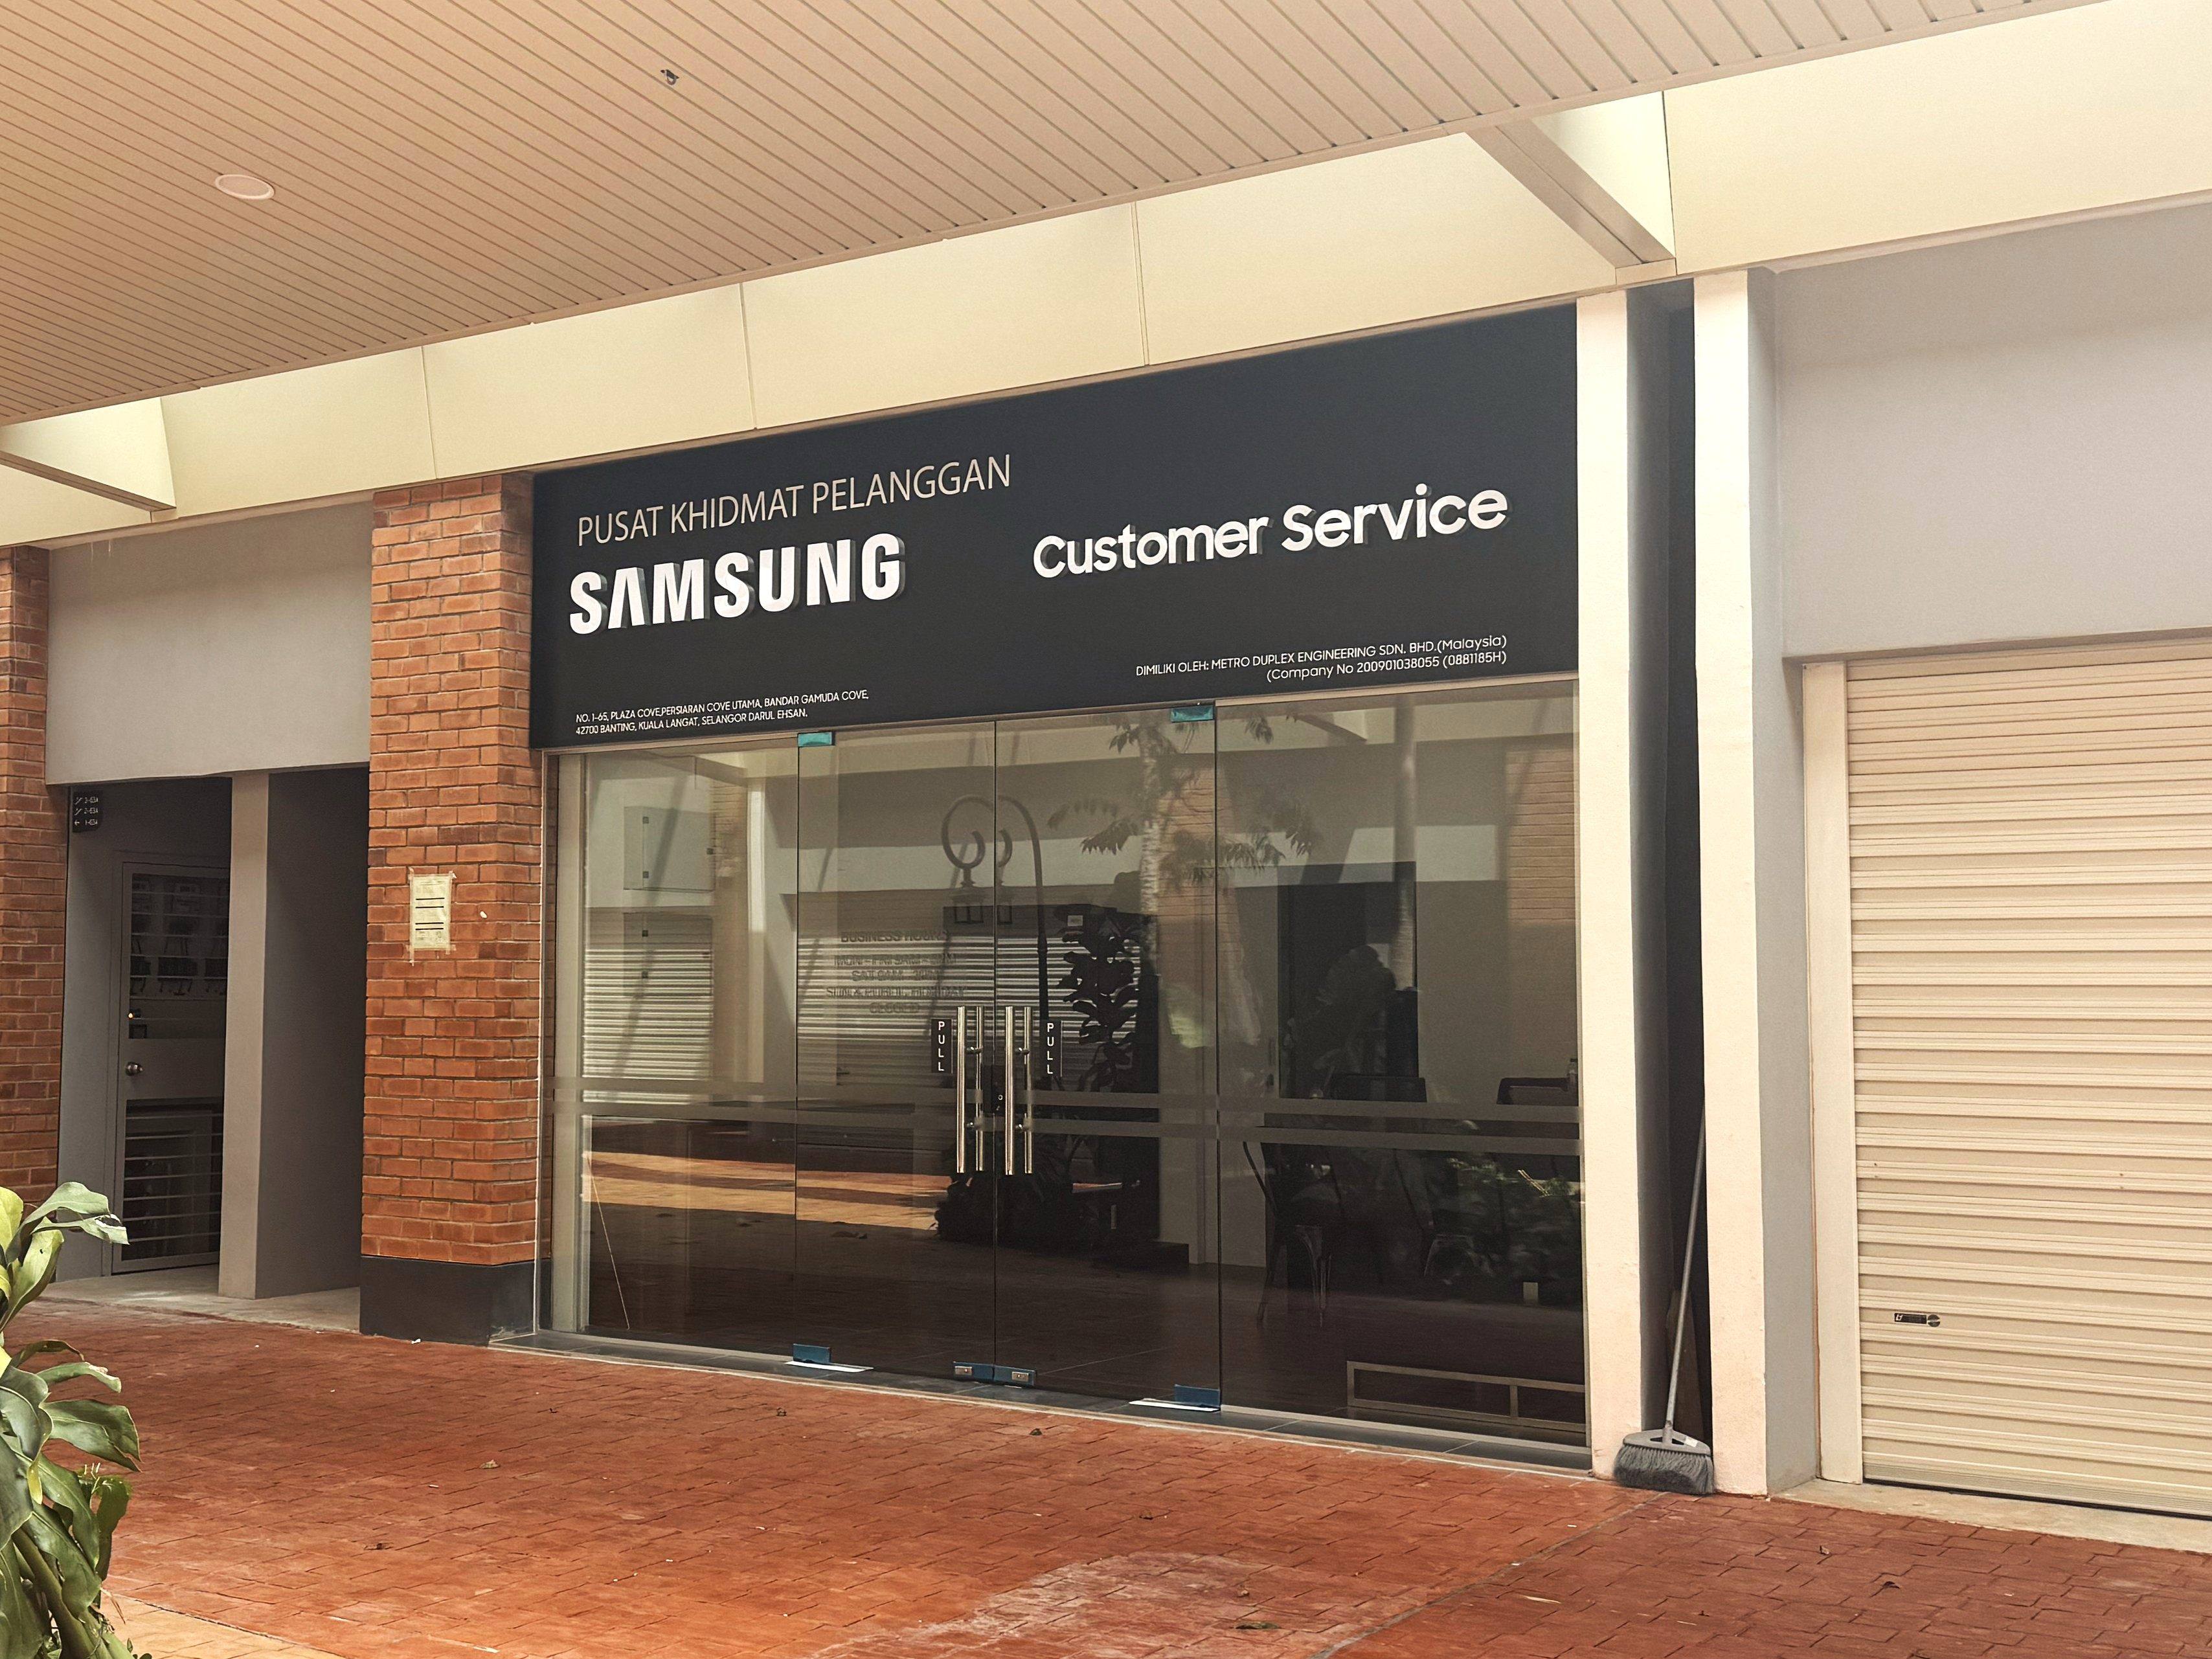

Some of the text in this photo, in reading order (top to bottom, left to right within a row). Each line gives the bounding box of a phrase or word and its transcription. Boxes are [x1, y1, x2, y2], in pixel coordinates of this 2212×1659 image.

[578, 455, 1010, 547] PUSAT KHIDMAT PELANGGAN
[1033, 483, 1508, 578] Customer Service
[569, 533, 904, 635] SAMSUNG
[1136, 663, 1175, 676] DIMILIKI
[1178, 660, 1209, 673] OLEH:
[1211, 657, 1250, 670] METRO
[1252, 653, 1294, 666] DUPLEX
[1298, 646, 1376, 662] ENGINEERING
[1379, 644, 1406, 656] SDN.
[1267, 651, 1507, 683] (Company No 200901038055 (0881185H)
[576, 714, 590, 723] NO.
[611, 710, 635, 720] PLAZA
[706, 701, 730, 712] COVE
[732, 699, 762, 710] UTAMA,
[764, 695, 800, 707] BANDAR
[801, 692, 840, 704] GAMUDA
[576, 725, 599, 735] 42700
[638, 720, 664, 730] KUALA
[666, 717, 700, 728] LANGAT,
[701, 713, 747, 725] SELANGOR
[749, 710, 775, 721] DARUL
[777, 708, 807, 719] EHSAN.
[841, 931, 901, 943] BUSINESS
